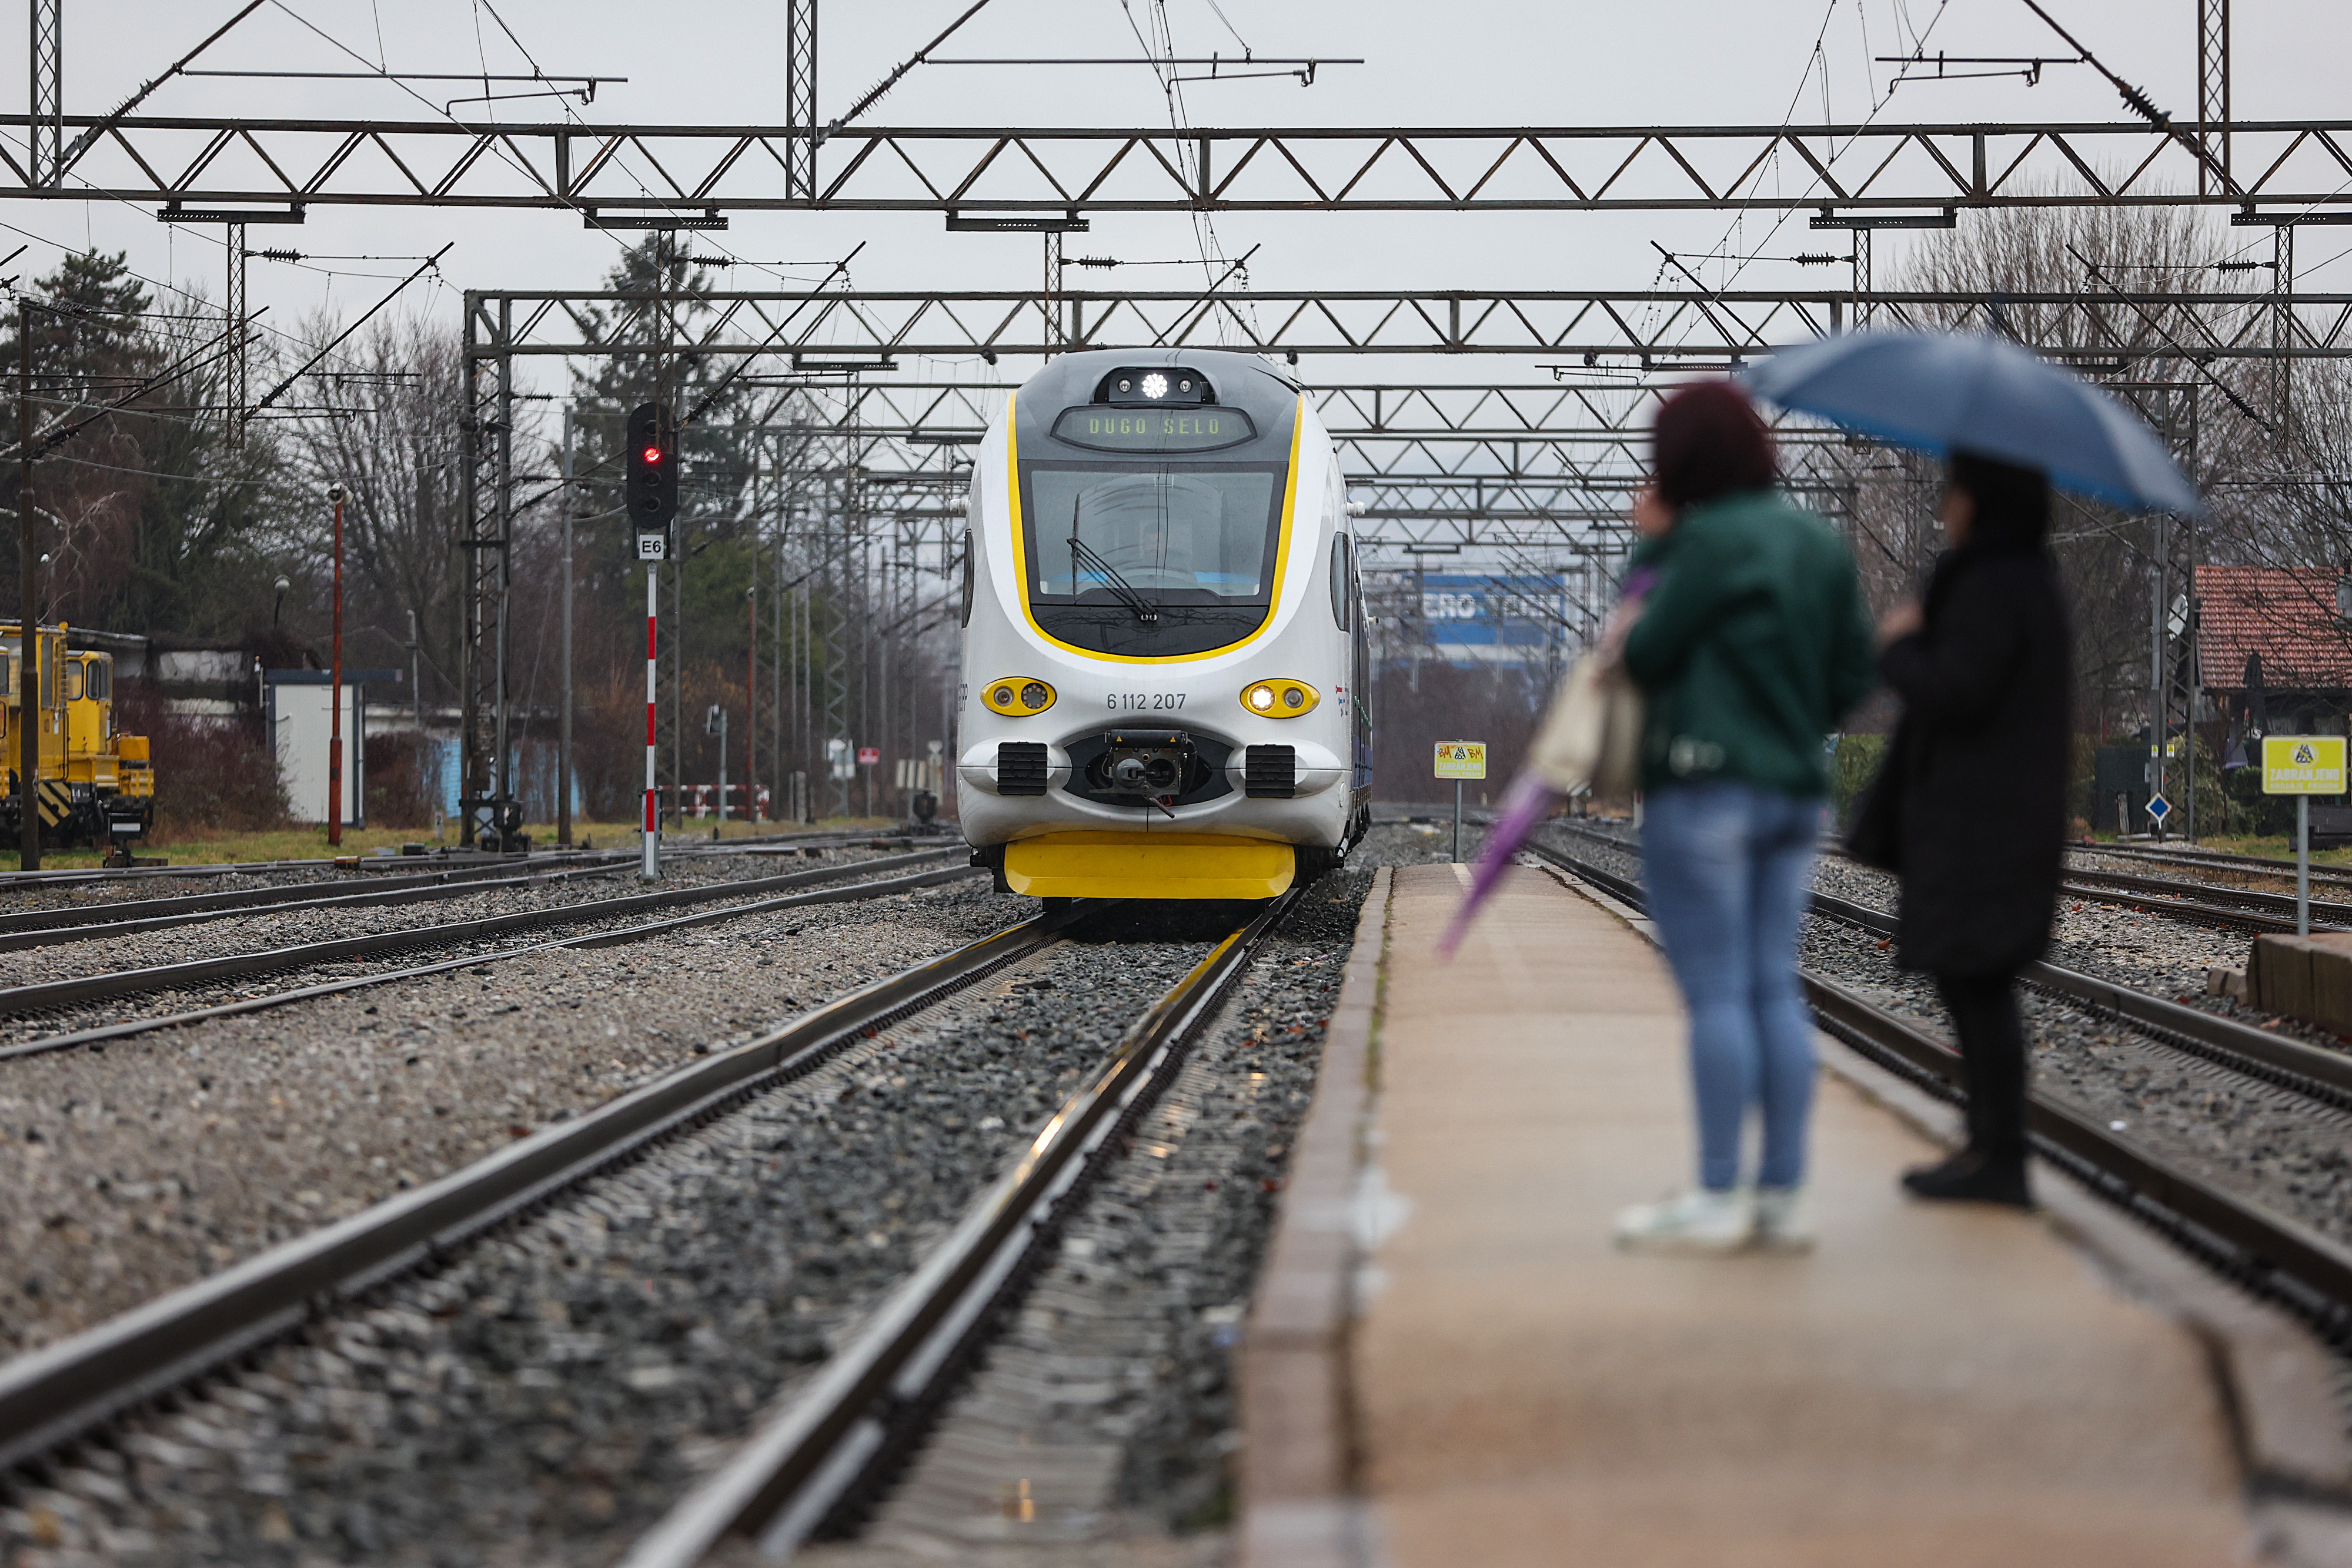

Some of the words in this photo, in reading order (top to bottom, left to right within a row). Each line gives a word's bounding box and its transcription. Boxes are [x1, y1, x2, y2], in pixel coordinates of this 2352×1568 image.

[1090, 418, 1146, 434] DUGO
[1164, 418, 1219, 434] SELO
[642, 540, 662, 553] E6
[1107, 693, 1117, 710] 6
[1122, 693, 1147, 710] 112
[1153, 693, 1186, 710] 207
[1438, 745, 1452, 758] BM
[1467, 747, 1484, 760] BM
[1439, 762, 1482, 771] ZABRANJENO
[2270, 768, 2340, 781] ZABRANJENO
